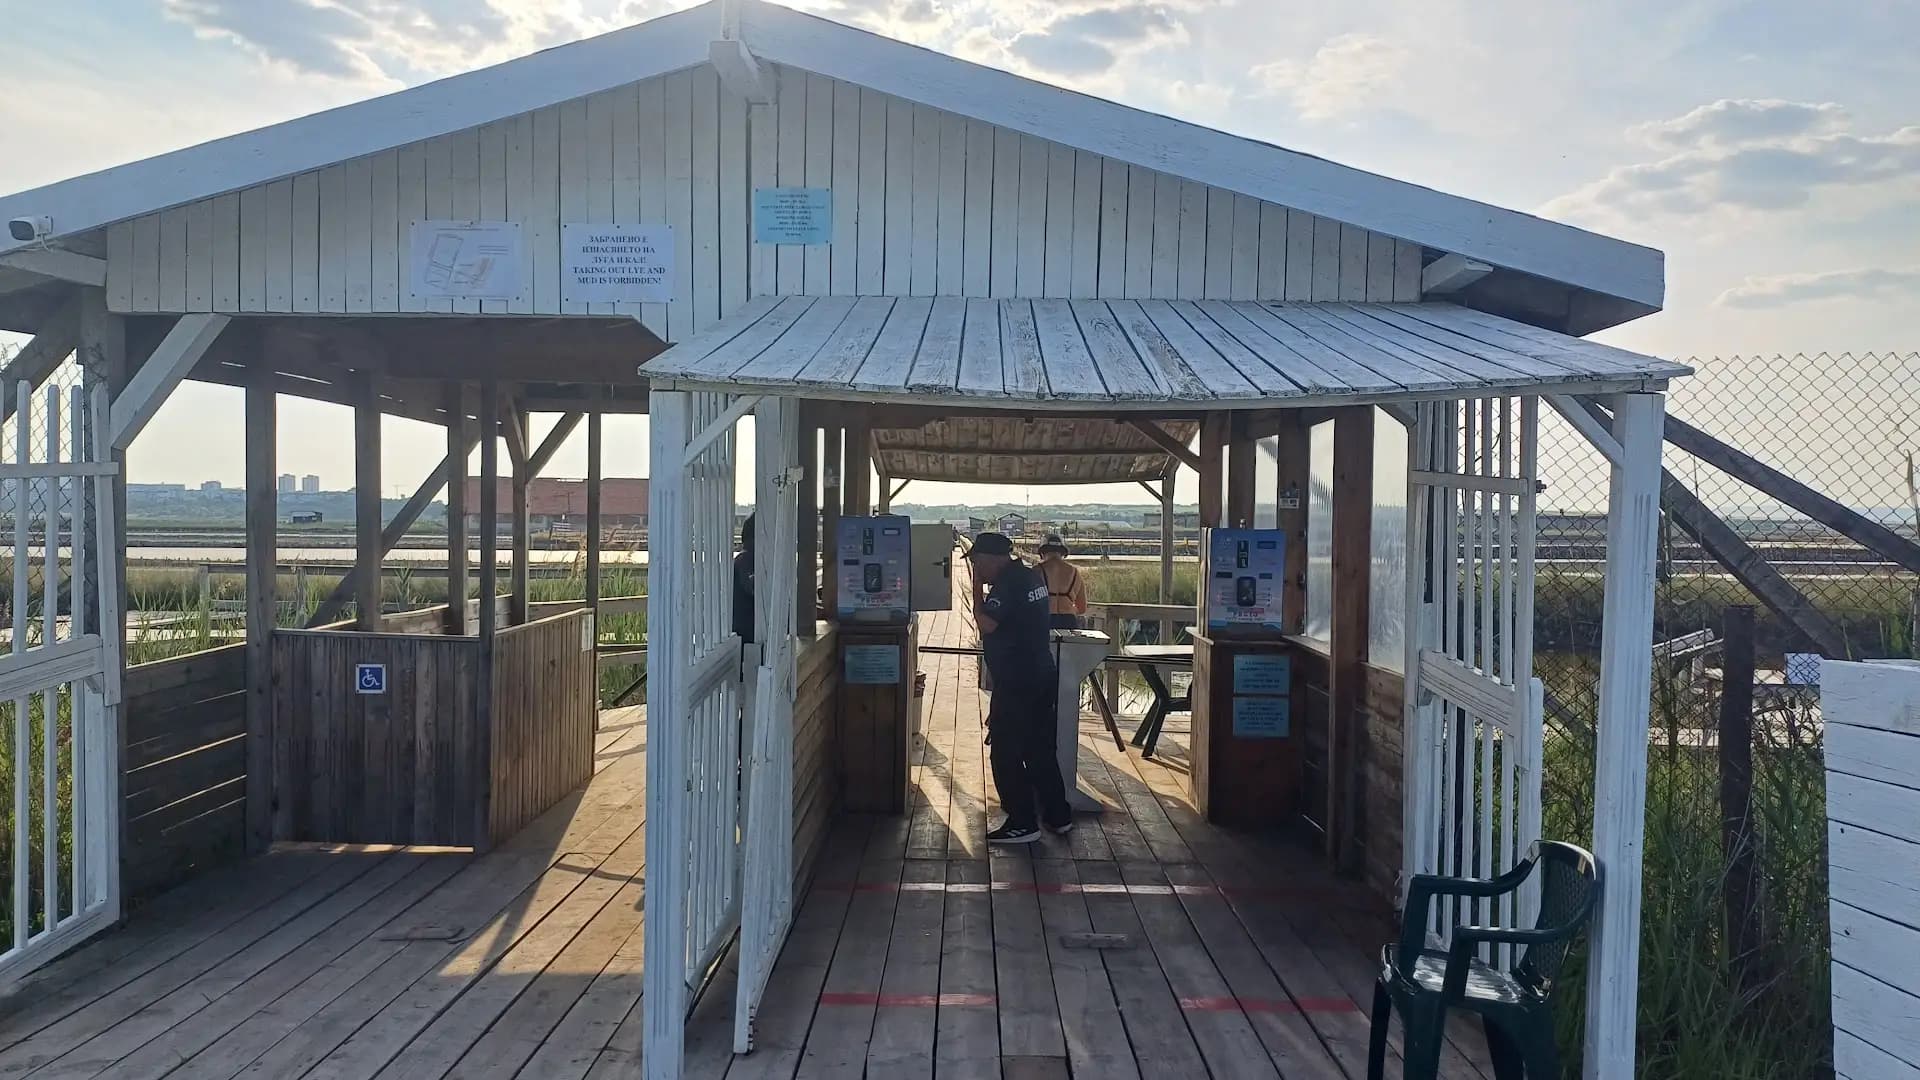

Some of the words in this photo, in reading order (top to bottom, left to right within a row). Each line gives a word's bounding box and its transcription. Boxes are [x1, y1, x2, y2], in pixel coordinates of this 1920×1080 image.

[590, 235, 641, 243] ЗАБРАНЕНО
[582, 246, 641, 254] ИЗНАСЯНЕТО
[643, 246, 656, 254] НА
[592, 256, 615, 264] ЛУГА
[573, 266, 606, 274] TAKING
[608, 266, 626, 274] OUT
[628, 266, 646, 274] LYE
[647, 266, 666, 274] AND
[577, 276, 598, 285] MUD
[608, 276, 662, 285] FORBIDDEN!
